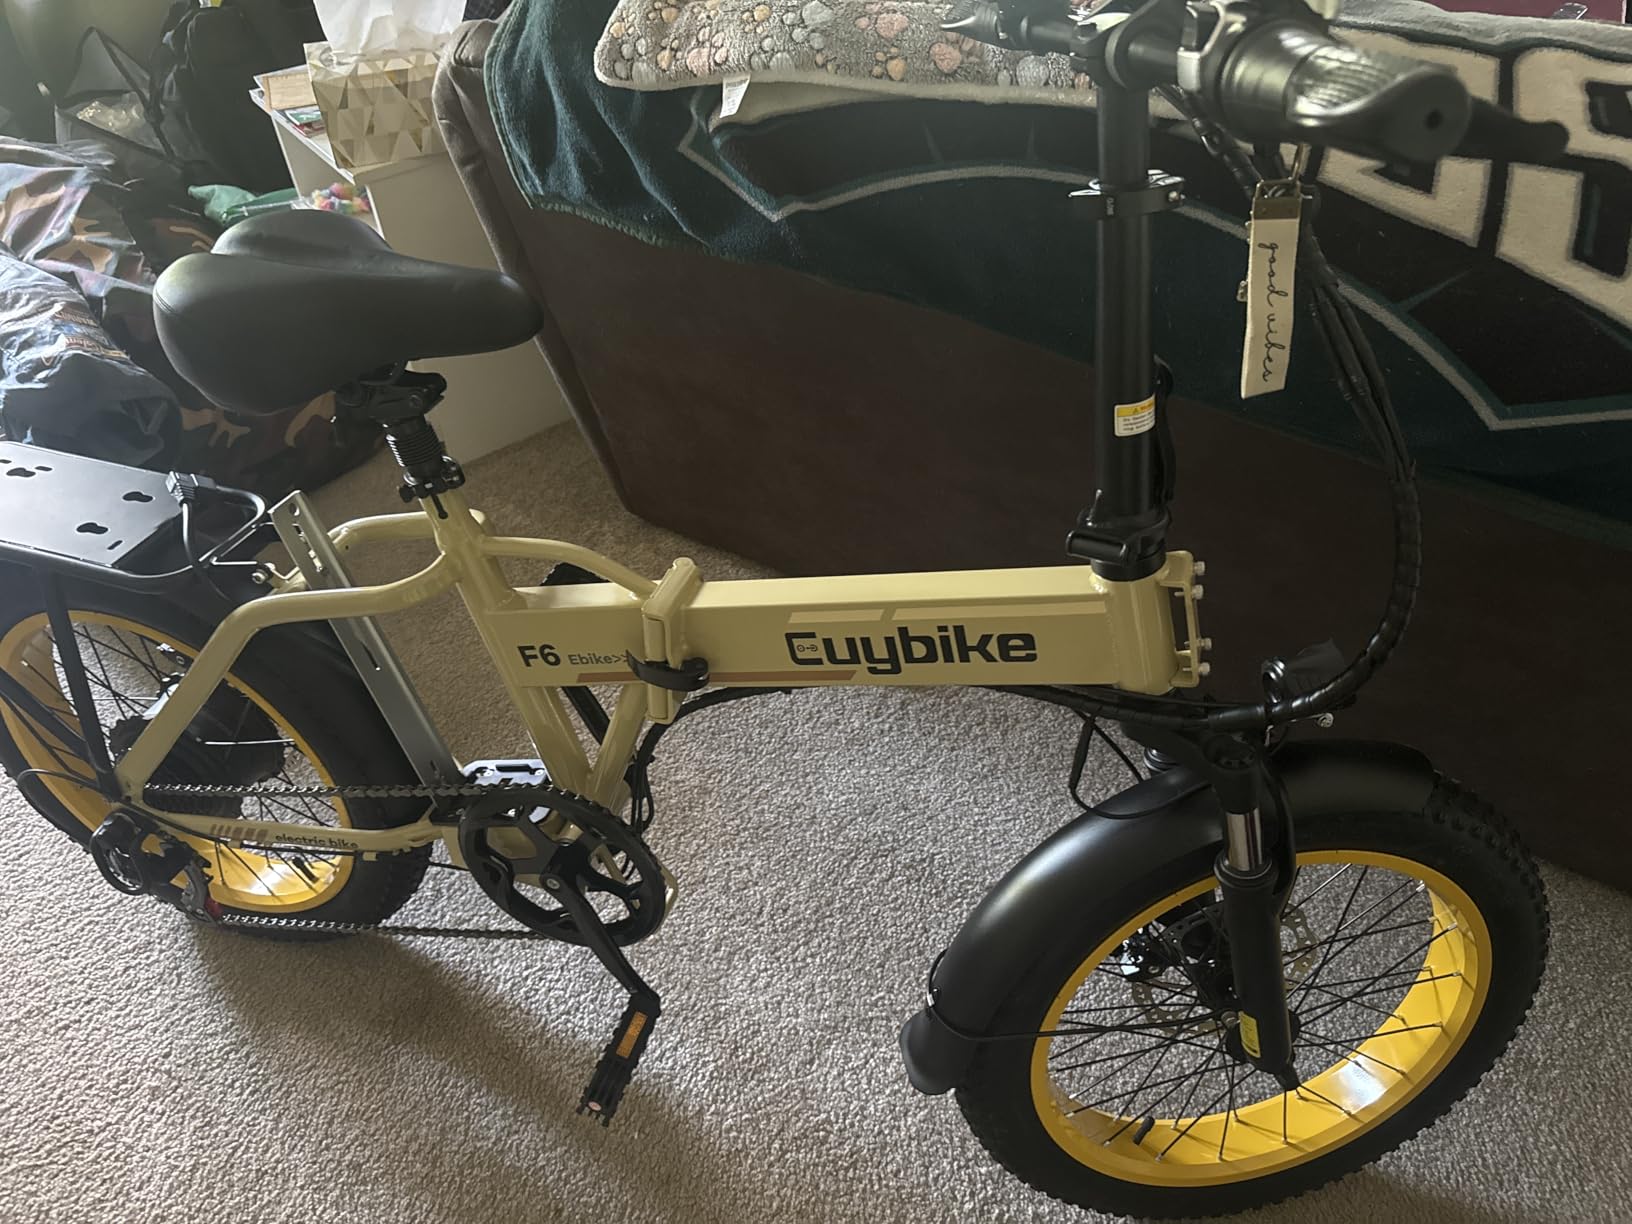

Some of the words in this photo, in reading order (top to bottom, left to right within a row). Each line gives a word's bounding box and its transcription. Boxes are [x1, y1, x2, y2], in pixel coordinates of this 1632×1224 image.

[1258, 243, 1288, 307] good
[1262, 313, 1286, 382] vibes
[517, 644, 561, 667] F6
[275, 833, 326, 846] electric
[328, 838, 359, 849] bike
